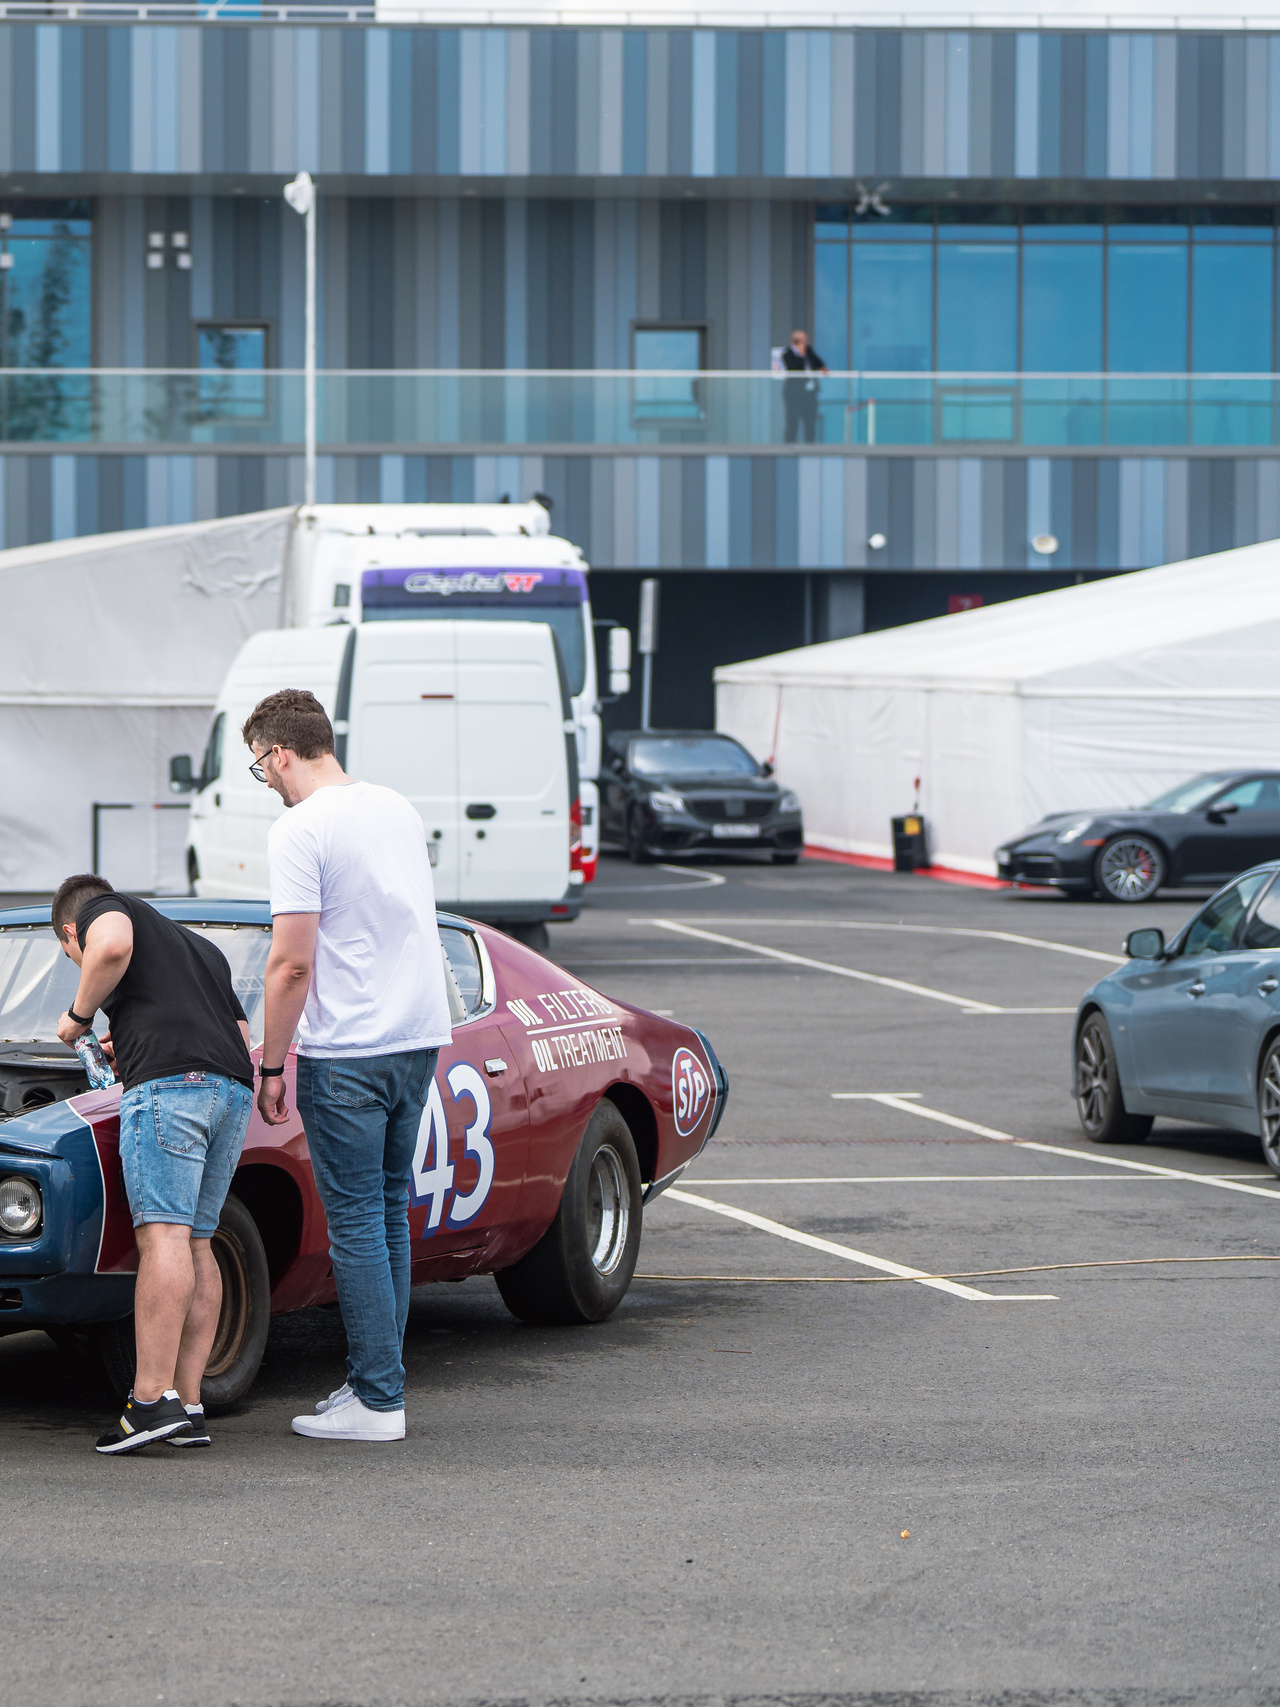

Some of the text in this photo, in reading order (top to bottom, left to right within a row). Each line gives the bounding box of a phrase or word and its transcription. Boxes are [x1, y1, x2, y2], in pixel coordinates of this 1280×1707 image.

[506, 989, 613, 1027] OIL FILTERS
[531, 1027, 628, 1073] OIL TREATMENT
[678, 1058, 705, 1120] STP
[411, 1062, 495, 1232] 43
